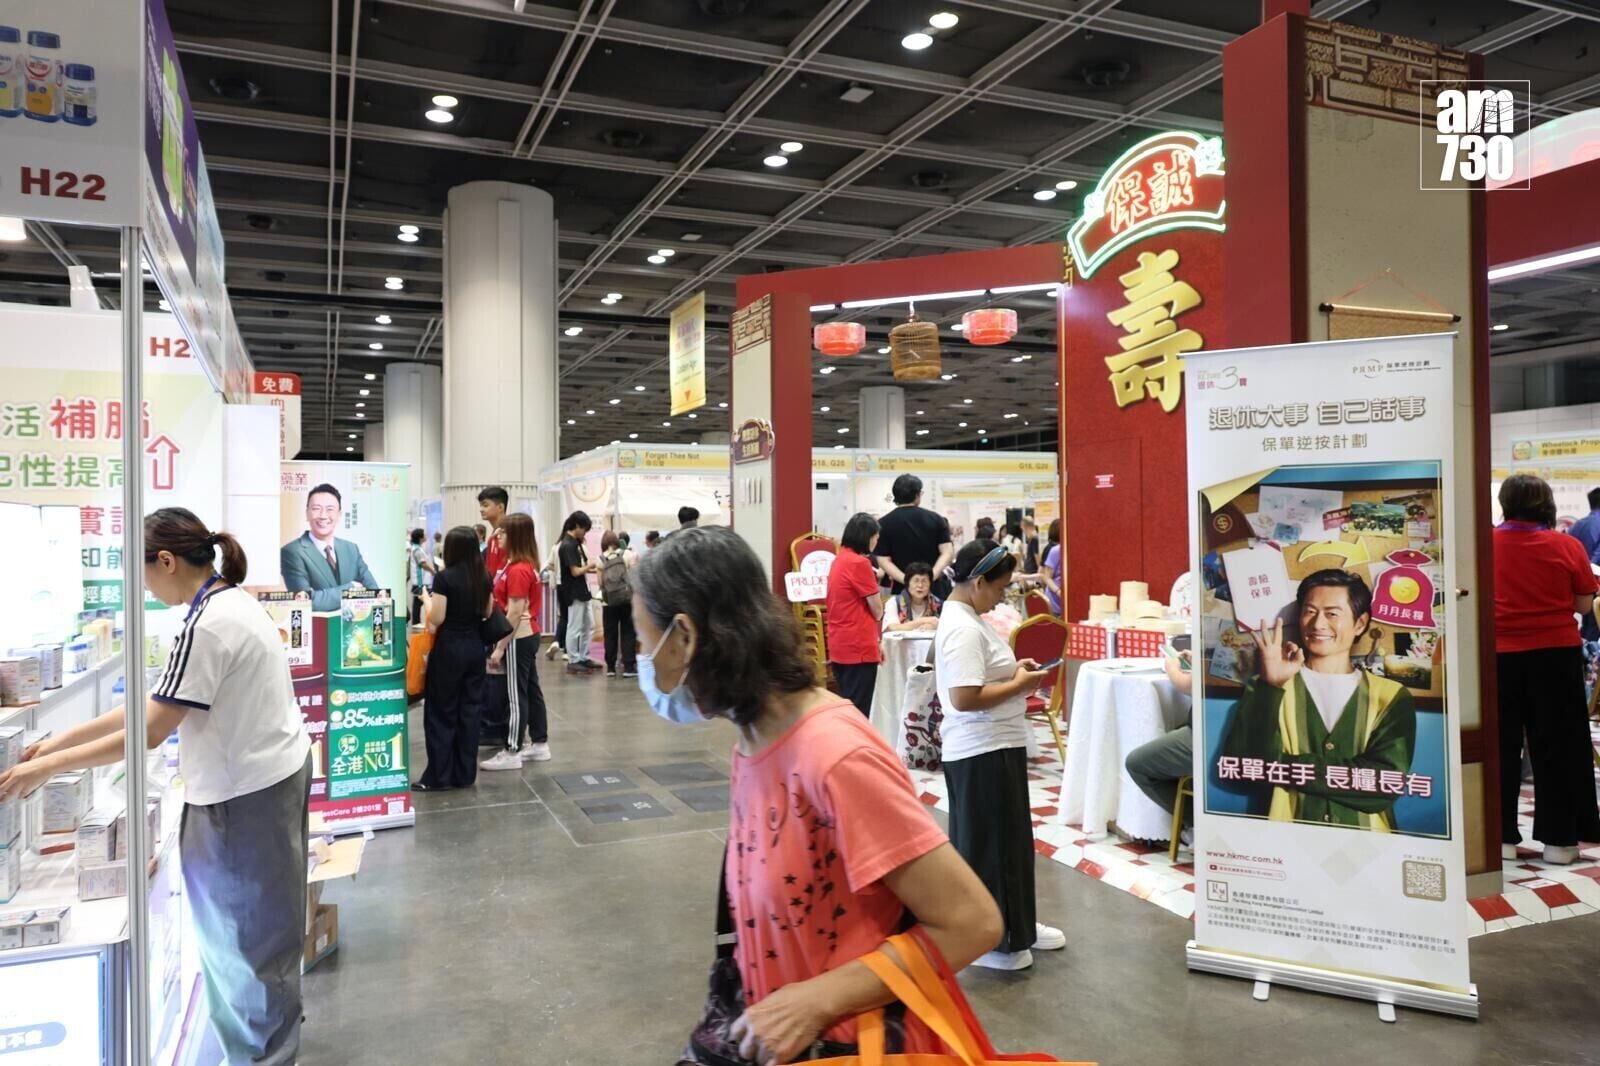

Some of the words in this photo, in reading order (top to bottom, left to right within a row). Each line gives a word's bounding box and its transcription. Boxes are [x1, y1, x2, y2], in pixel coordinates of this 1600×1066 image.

[20, 166, 107, 201] H22
[1106, 150, 1194, 234] 保誠
[1104, 248, 1204, 413] 壽
[150, 337, 196, 358] H2
[262, 376, 294, 393] 免費
[1209, 402, 1309, 430] 退休大事
[1317, 395, 1427, 425] 自己話事
[1261, 433, 1369, 452] 保單逆按計劃
[645, 451, 668, 460] Forget
[669, 452, 686, 460] Thee
[687, 453, 700, 461] Not
[1378, 604, 1424, 621] 月月長糧
[1216, 755, 1316, 786] 保單在手
[1325, 765, 1432, 797] 長糧長有
[1205, 849, 1284, 866] www.hkmc.com.hk
